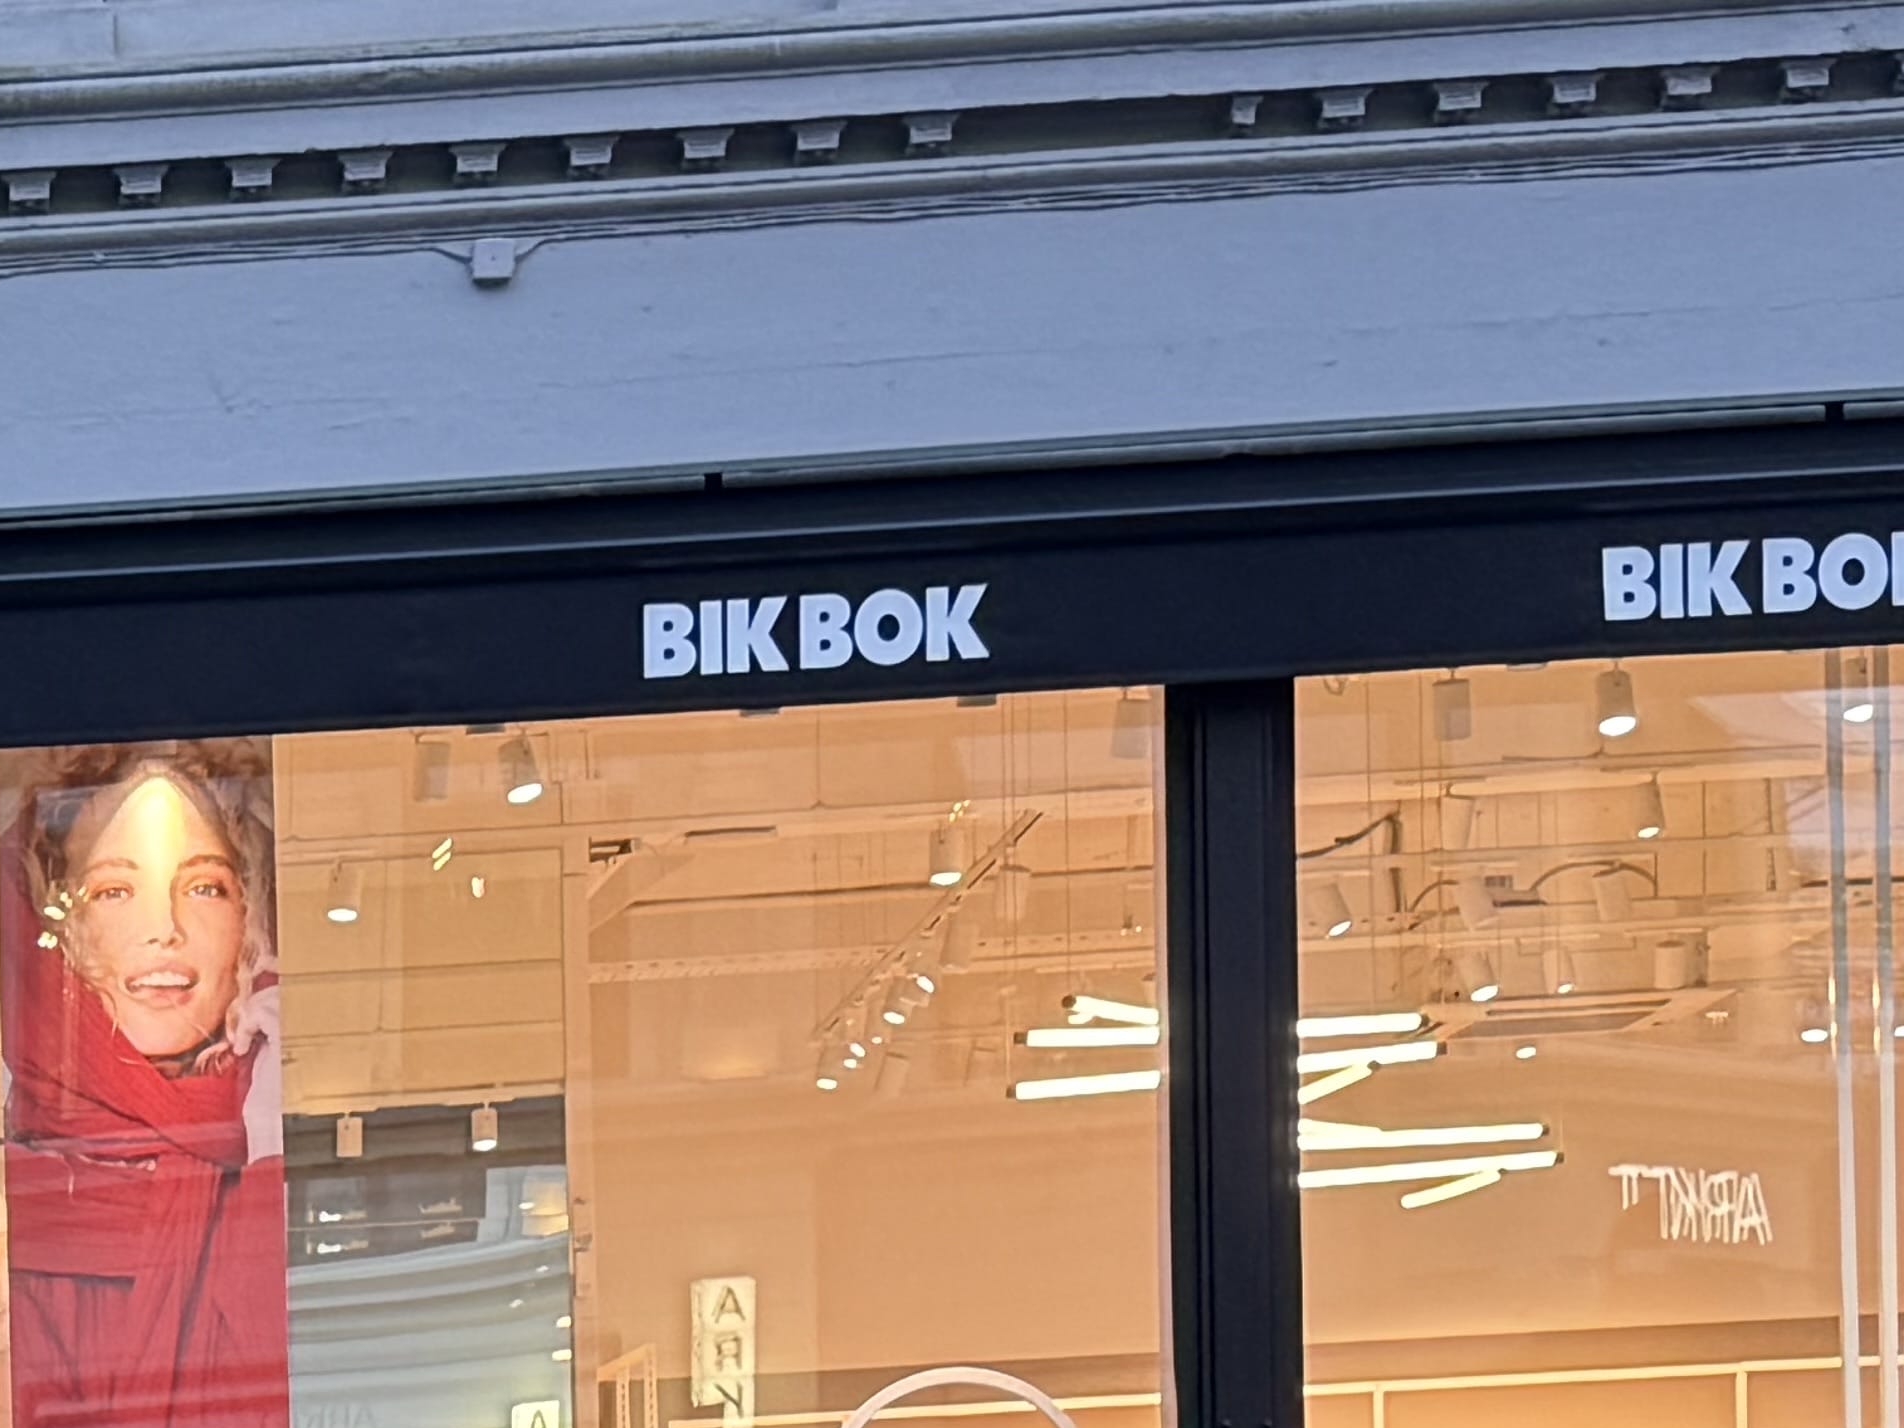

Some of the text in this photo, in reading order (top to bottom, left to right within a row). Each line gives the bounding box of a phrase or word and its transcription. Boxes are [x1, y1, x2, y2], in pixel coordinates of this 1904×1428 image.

[1602, 531, 1904, 621] BIK BO
[643, 583, 990, 679] BIK BOK
